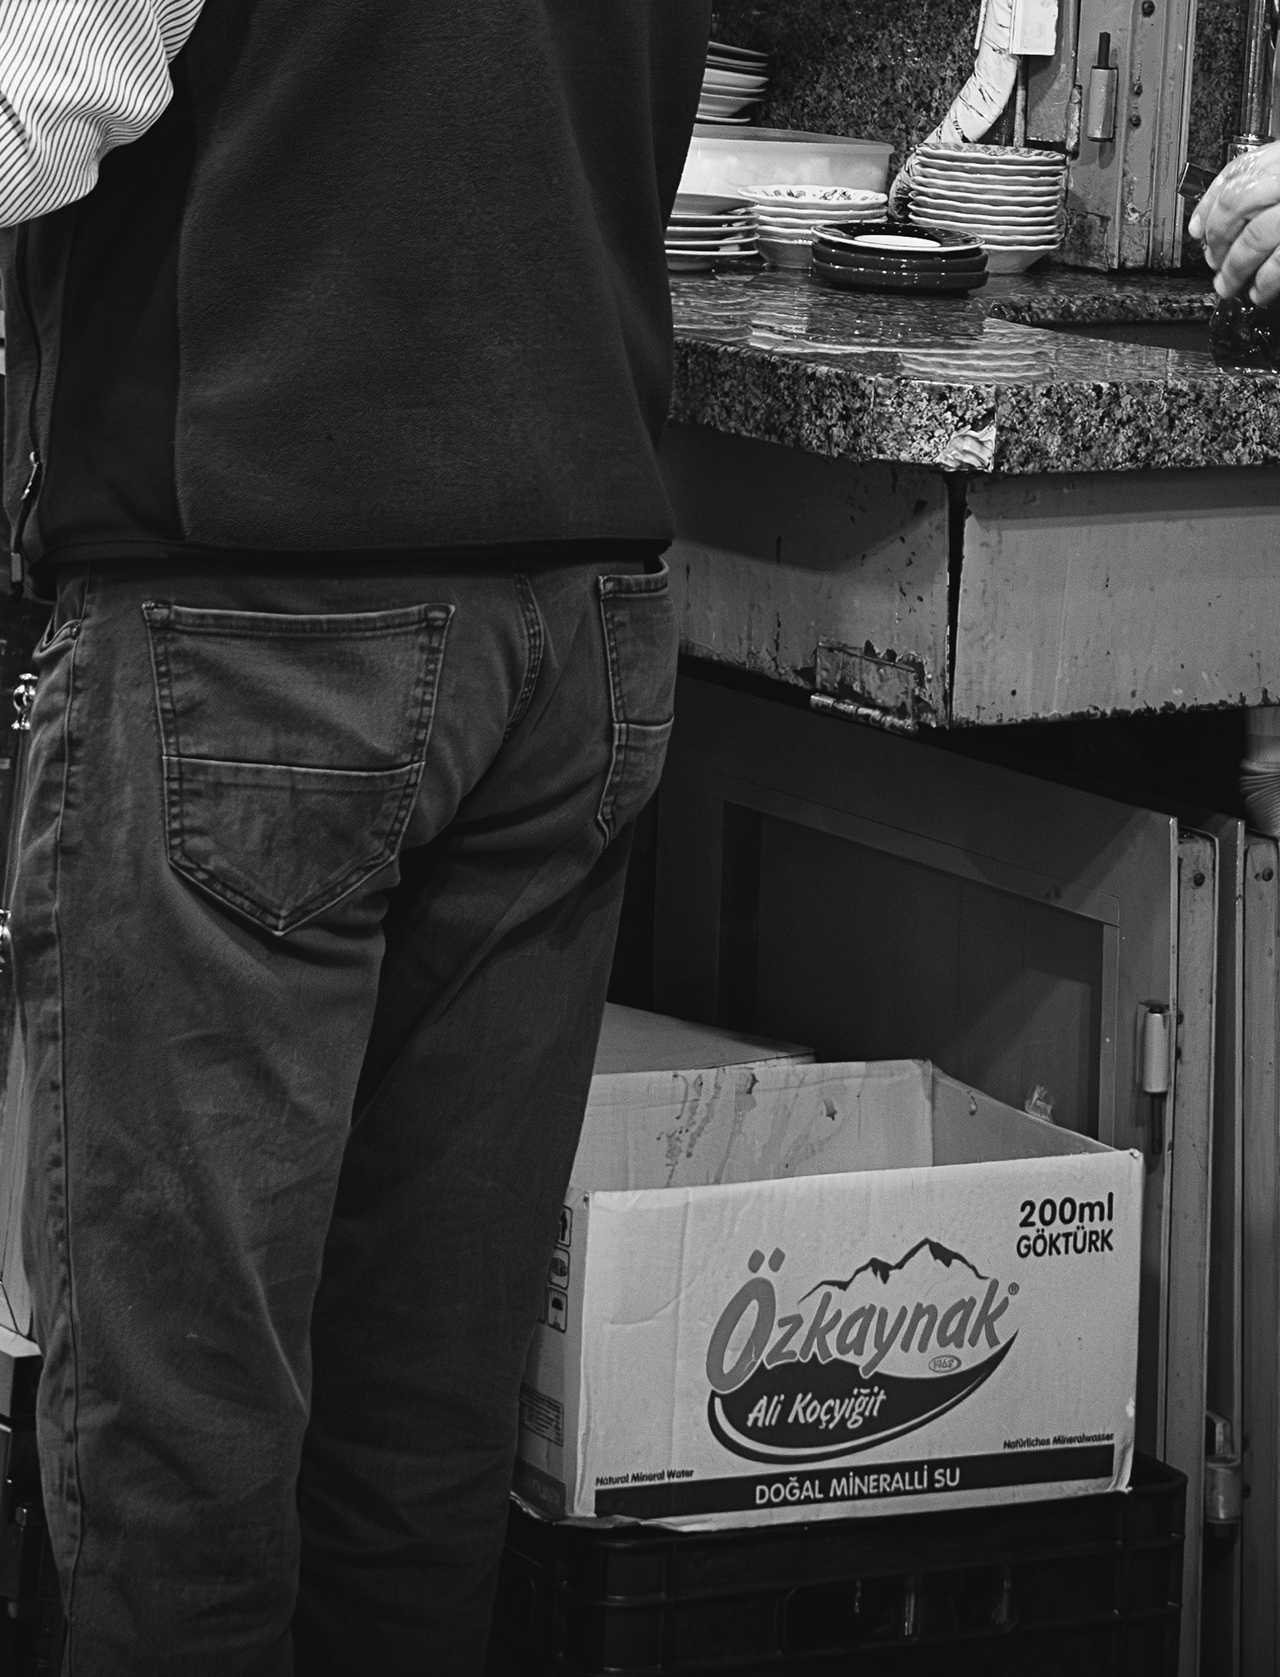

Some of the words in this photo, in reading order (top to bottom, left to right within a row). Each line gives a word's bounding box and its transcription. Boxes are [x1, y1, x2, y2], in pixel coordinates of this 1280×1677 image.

[1019, 1191, 1114, 1228] 200ml
[1016, 1225, 1113, 1259] GÖKTÜRK
[706, 1247, 1010, 1394] Özkaynak
[747, 1394, 785, 1427] Ali
[788, 1386, 887, 1430] Koçyiğit
[1003, 1437, 1051, 1451] Natürliches
[1051, 1432, 1115, 1447] Mineralwasser
[595, 1474, 630, 1487] Natural
[630, 1470, 665, 1483] Mineral
[666, 1469, 694, 1480] Water
[755, 1473, 824, 1505] DOĞAL
[829, 1466, 928, 1499] MİNERALLİ
[934, 1467, 961, 1489] SU
